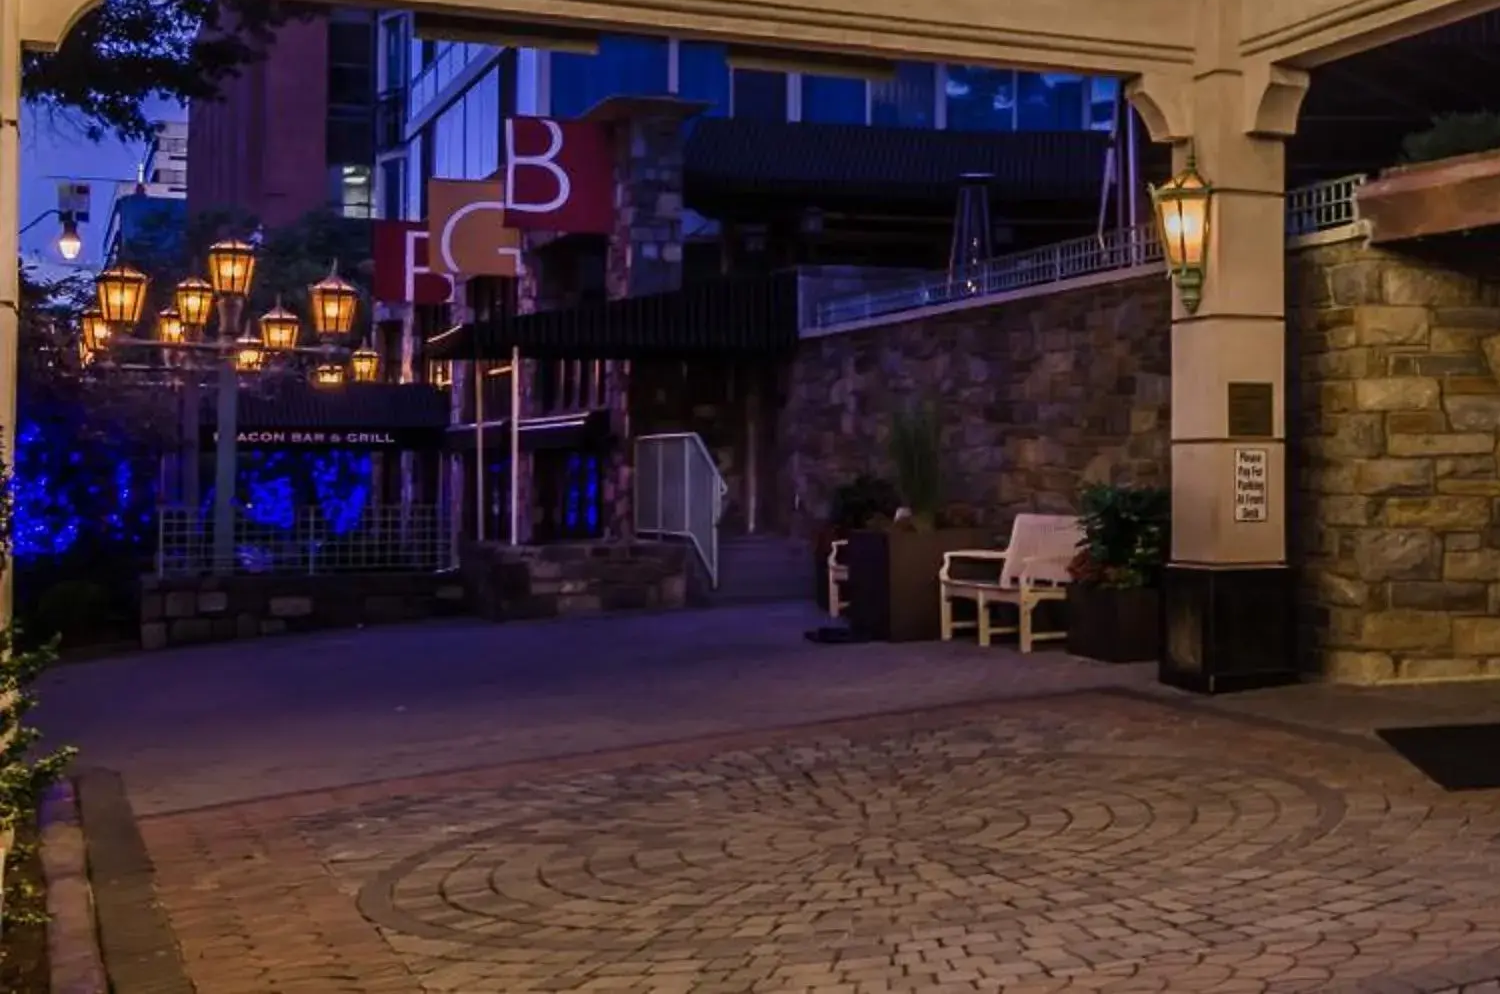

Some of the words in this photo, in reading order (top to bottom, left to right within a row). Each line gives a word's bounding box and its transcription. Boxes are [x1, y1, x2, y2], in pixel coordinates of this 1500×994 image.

[505, 118, 571, 213] B
[213, 432, 285, 443] ACON
[291, 433, 325, 442] BAR
[346, 433, 395, 443] GRILL
